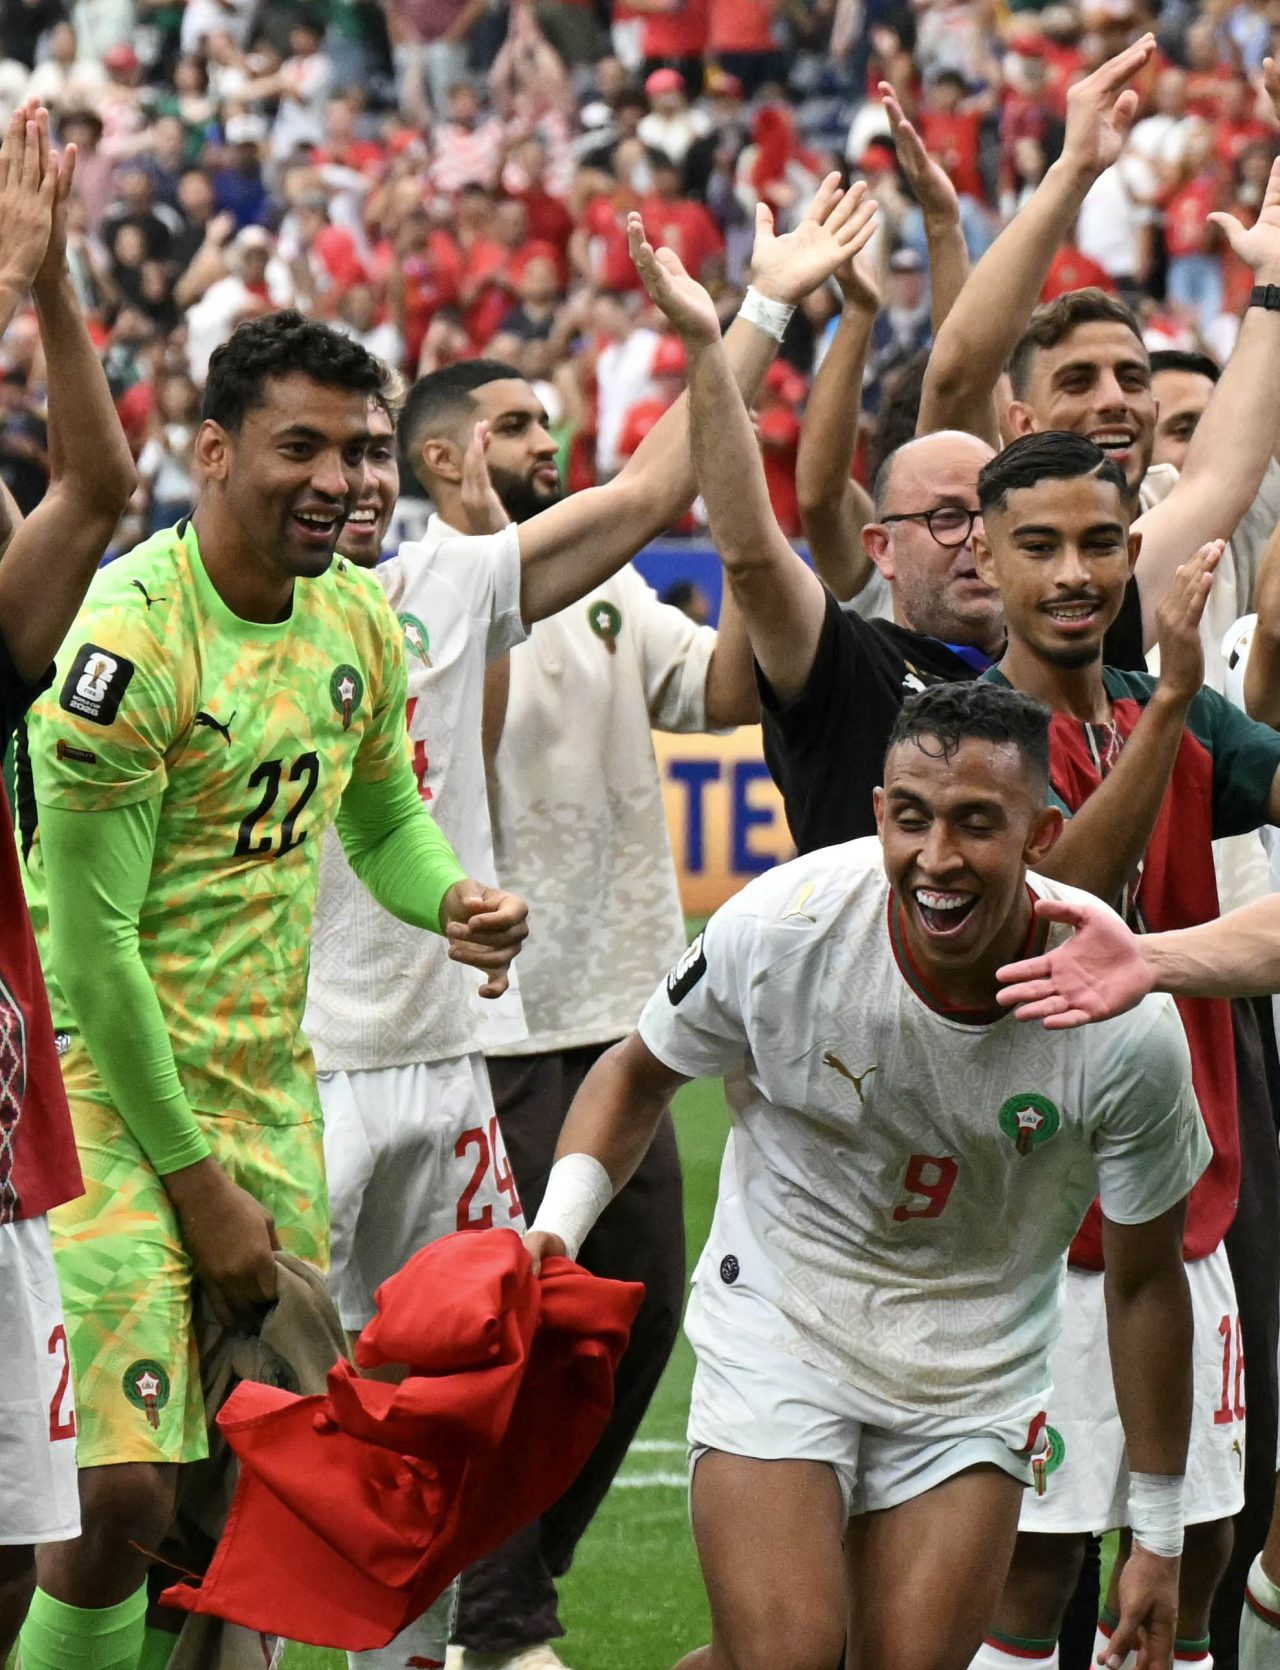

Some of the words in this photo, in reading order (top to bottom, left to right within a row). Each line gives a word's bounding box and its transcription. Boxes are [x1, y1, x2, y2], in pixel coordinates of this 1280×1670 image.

[69, 700, 99, 717] 2026
[233, 750, 320, 858] 22
[455, 1116, 522, 1231] 24
[893, 1154, 959, 1222] 9
